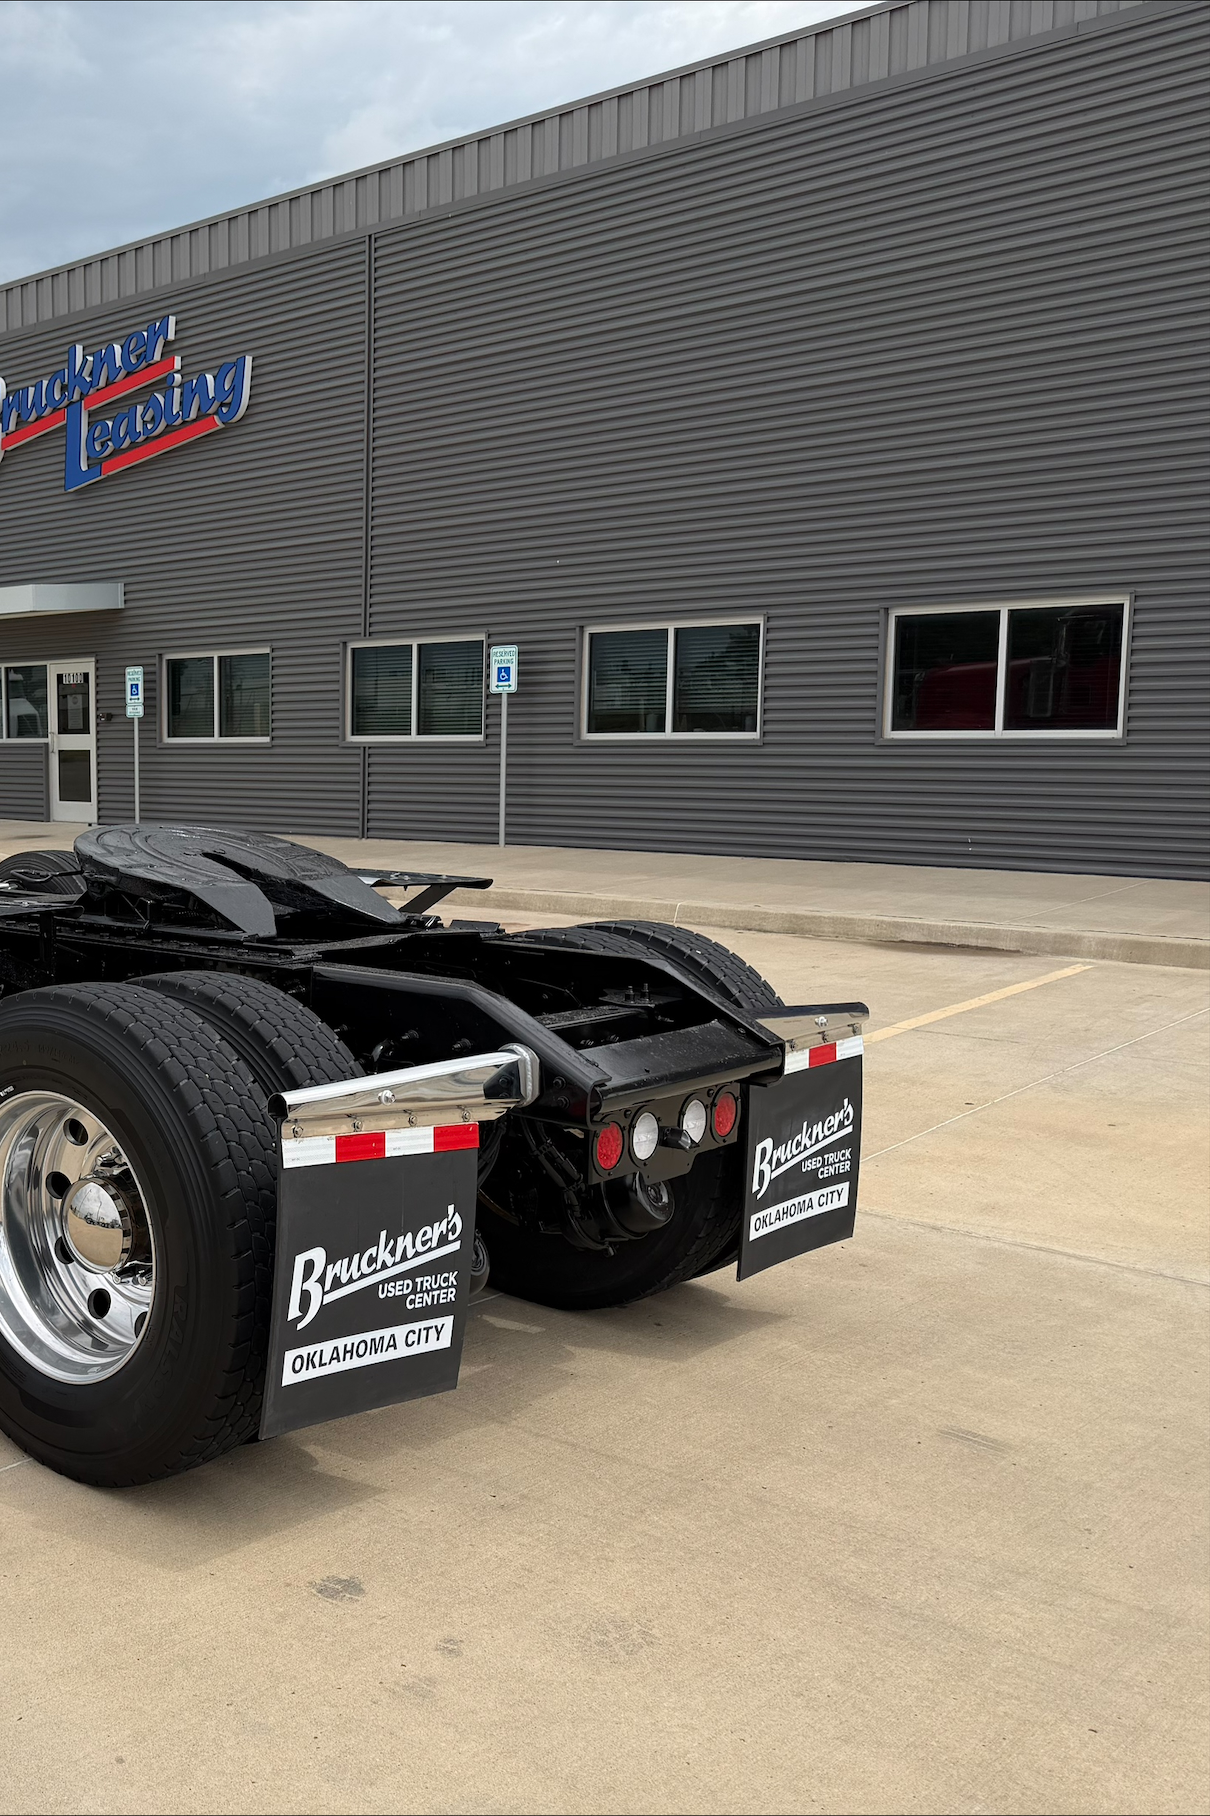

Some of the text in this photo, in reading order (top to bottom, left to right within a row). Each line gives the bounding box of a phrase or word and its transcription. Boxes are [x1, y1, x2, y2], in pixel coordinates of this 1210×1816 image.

[64, 355, 253, 491] Leasing
[751, 1098, 854, 1200] Bruckner's
[802, 1148, 851, 1172] USED TRUCK
[818, 1161, 851, 1179] CENTER
[754, 1188, 844, 1232] OKLAHOMA CITY
[287, 1204, 463, 1331] Bruckner's
[378, 1271, 459, 1299] USED TRUCK
[406, 1288, 457, 1310] CENTER
[291, 1323, 445, 1375] OKLAHOMA CITY
